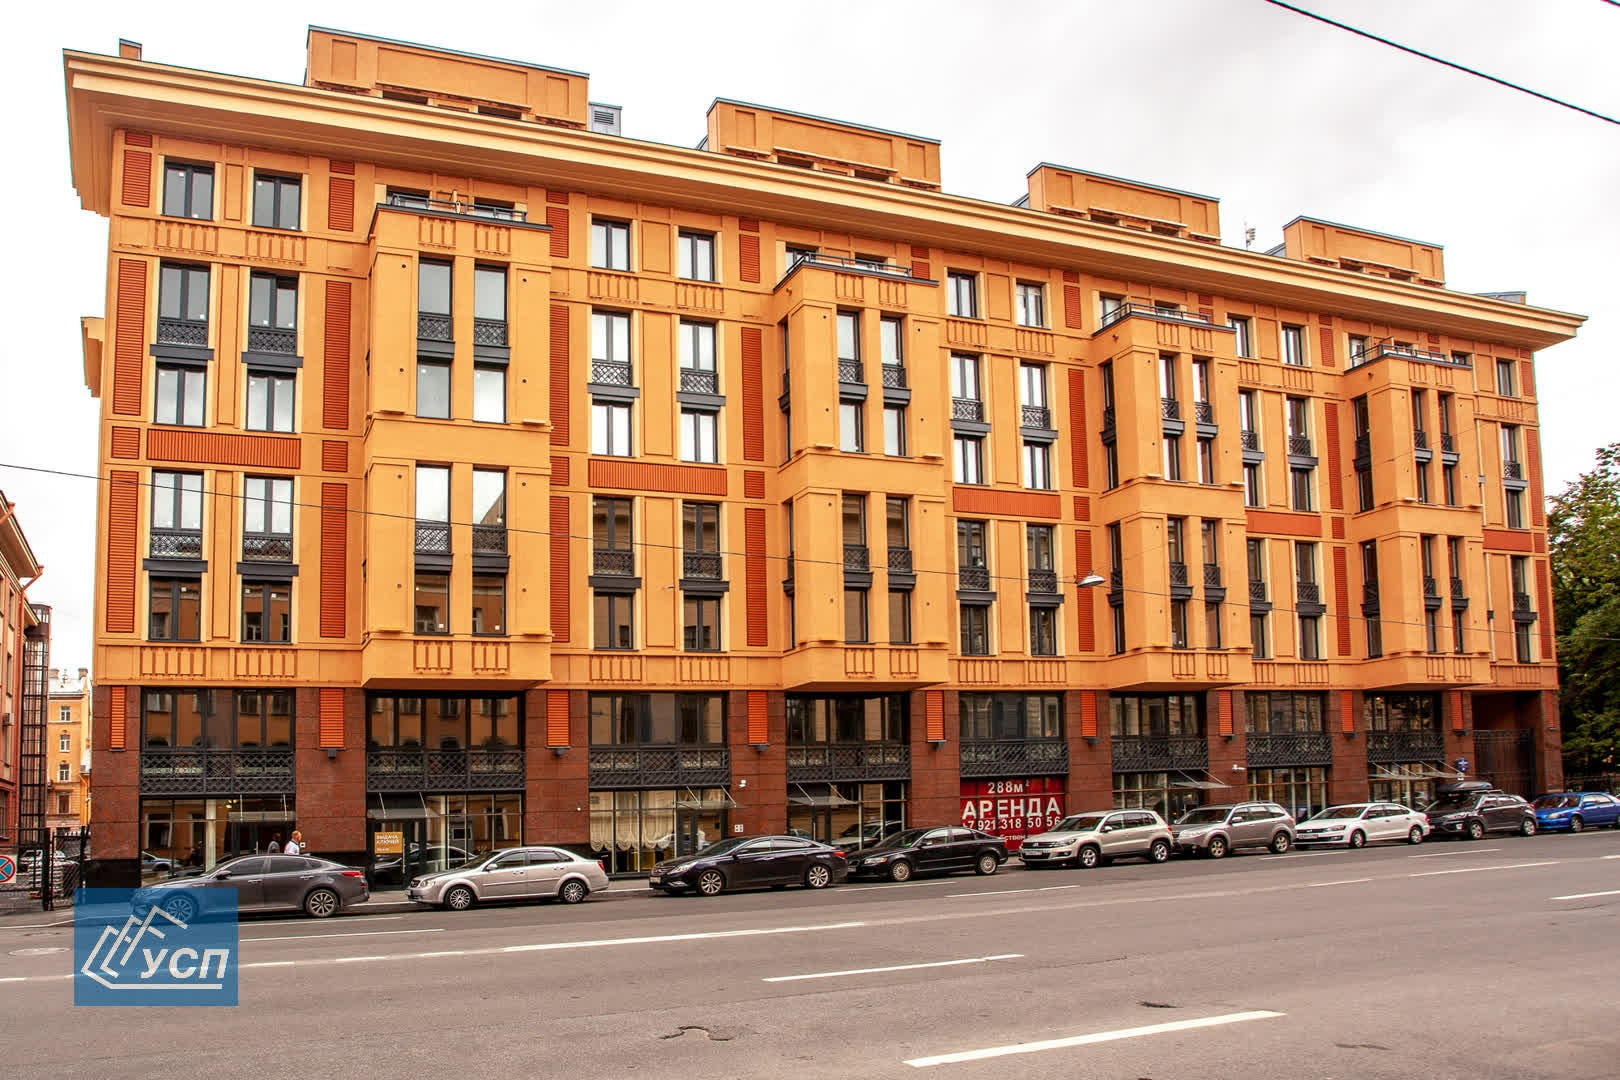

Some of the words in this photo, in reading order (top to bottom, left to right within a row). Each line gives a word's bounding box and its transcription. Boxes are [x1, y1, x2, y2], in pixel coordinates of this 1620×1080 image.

[962, 797, 1061, 820] АРЕНДА
[978, 819, 996, 831] 921
[1001, 818, 1022, 829] 318
[1028, 817, 1042, 828] 50
[1046, 816, 1061, 826] 56
